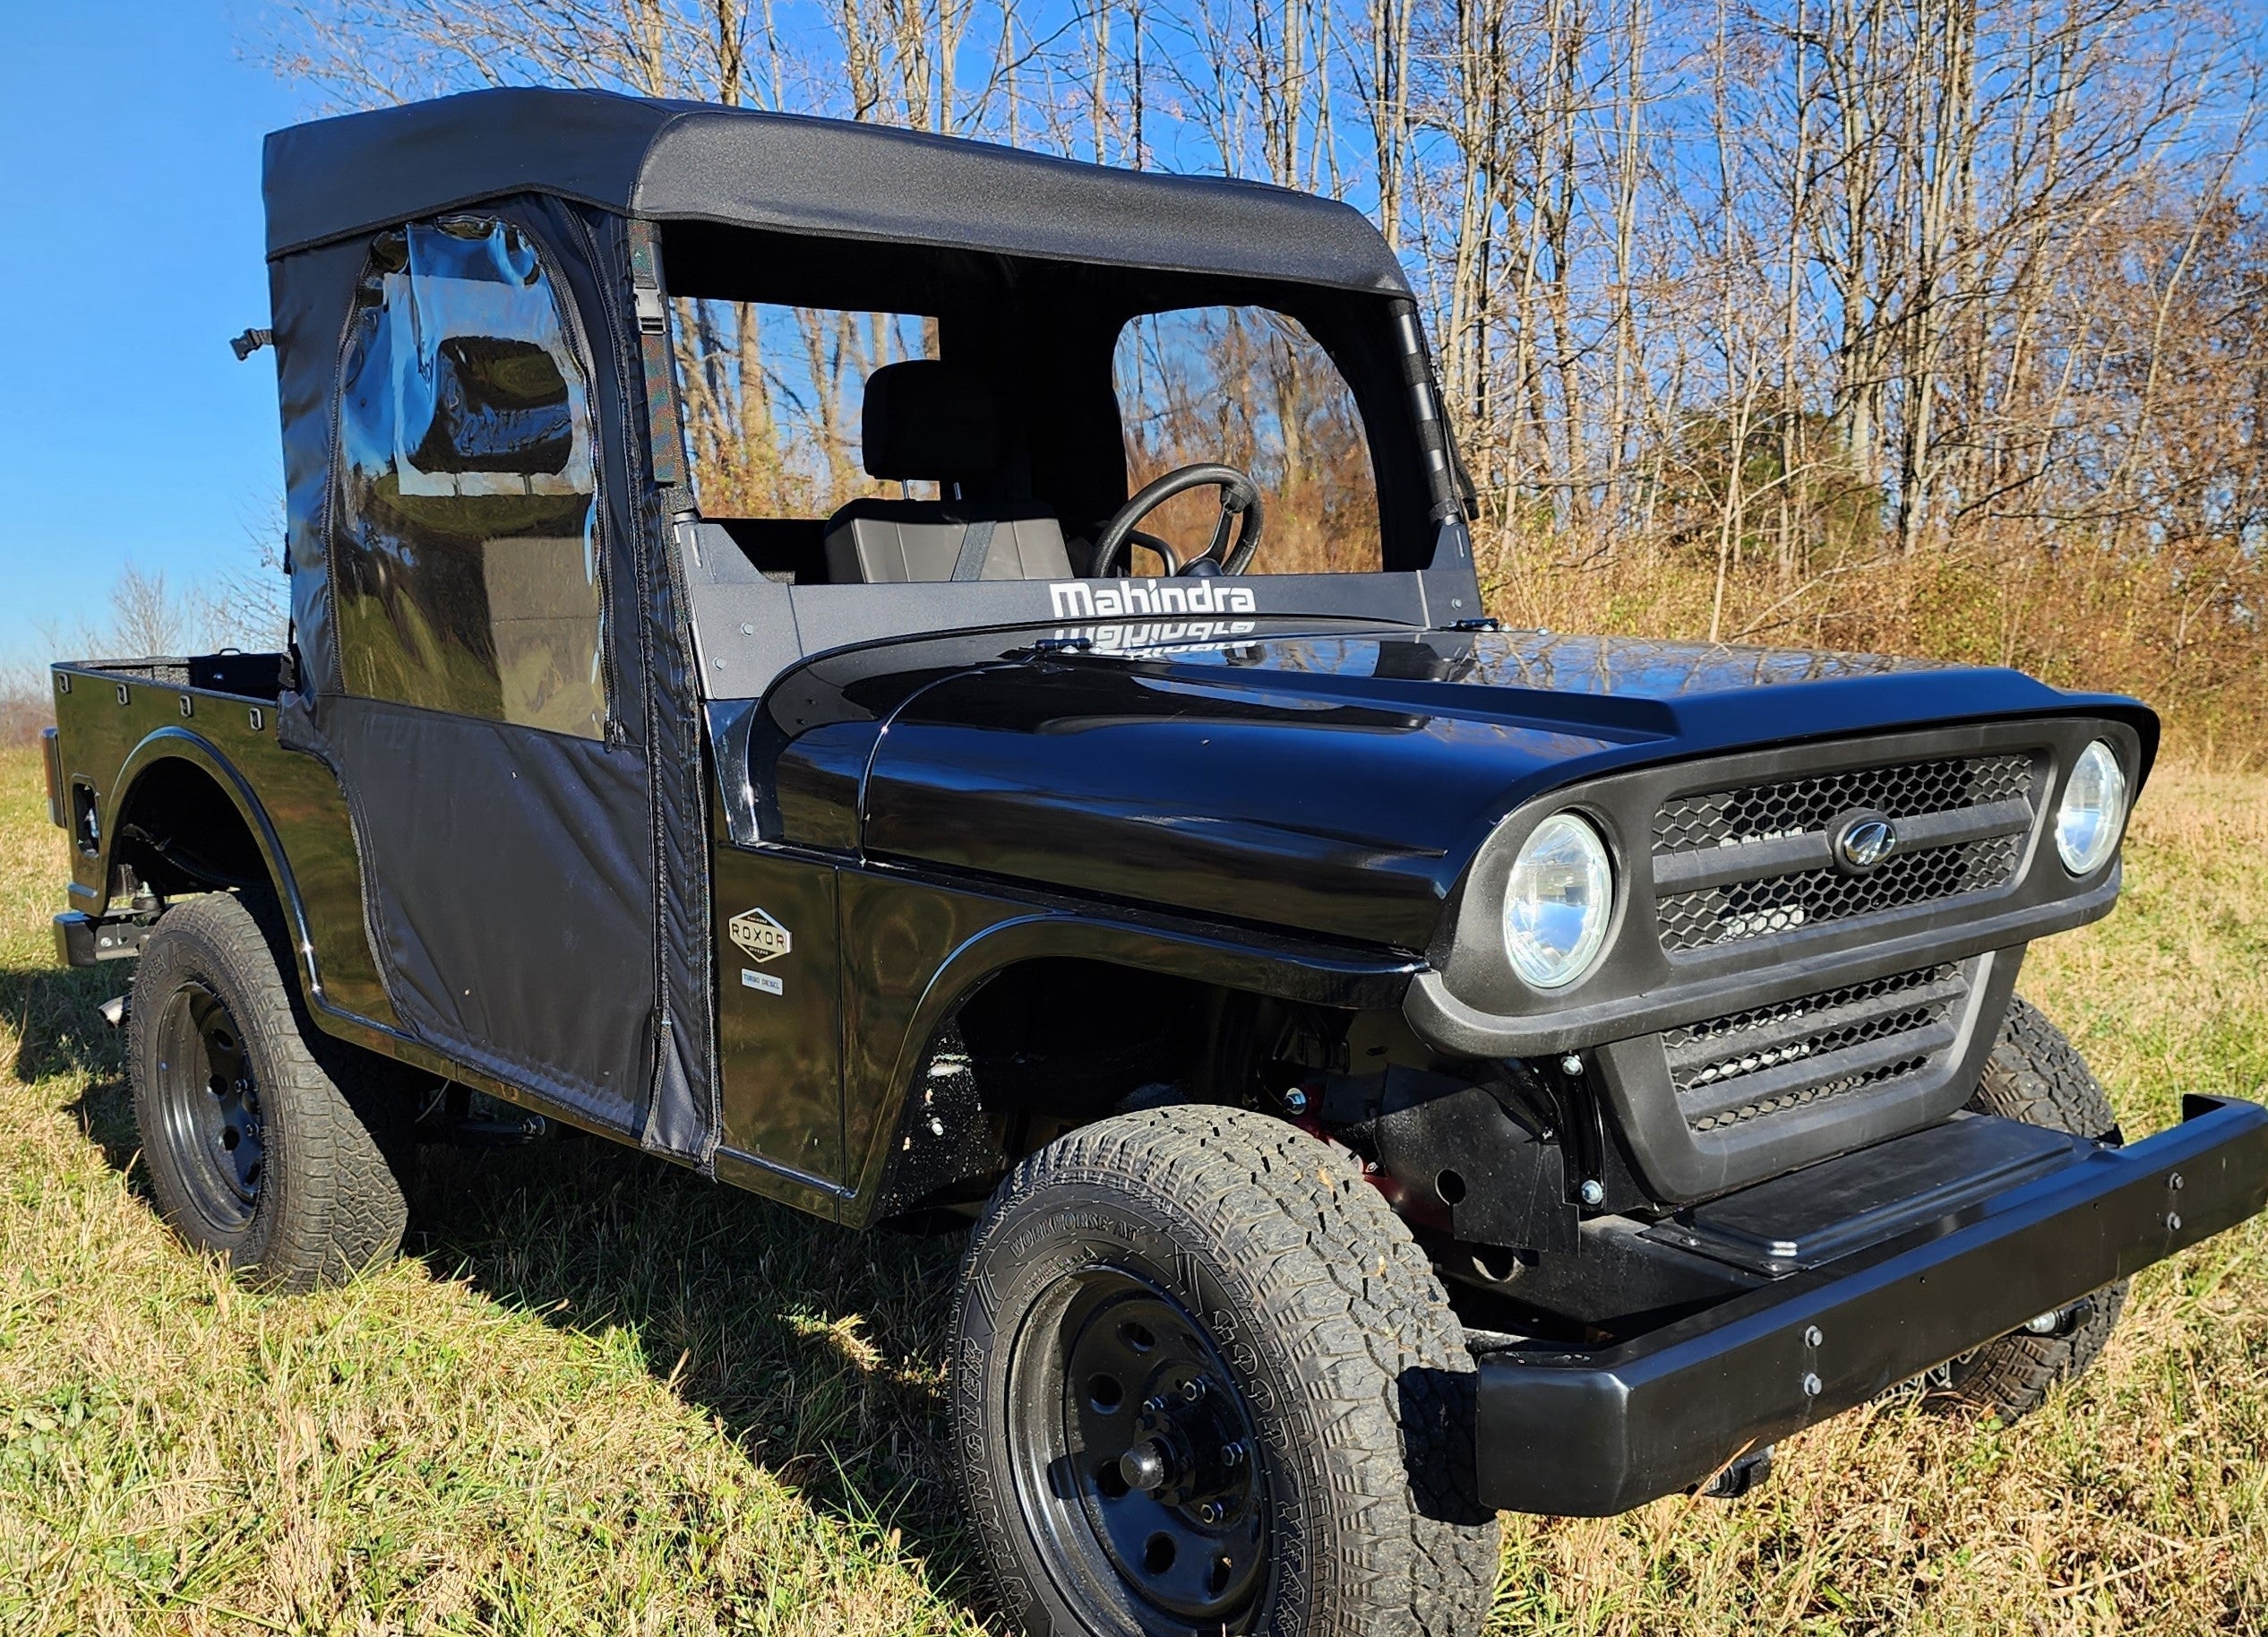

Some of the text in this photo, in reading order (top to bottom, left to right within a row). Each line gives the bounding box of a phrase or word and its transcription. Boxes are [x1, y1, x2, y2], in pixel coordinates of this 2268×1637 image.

[731, 924, 785, 948] ROXOR
[1009, 1211, 1139, 1259] WORKHORSE AT
[958, 1337, 1034, 1618] WRANGLER
